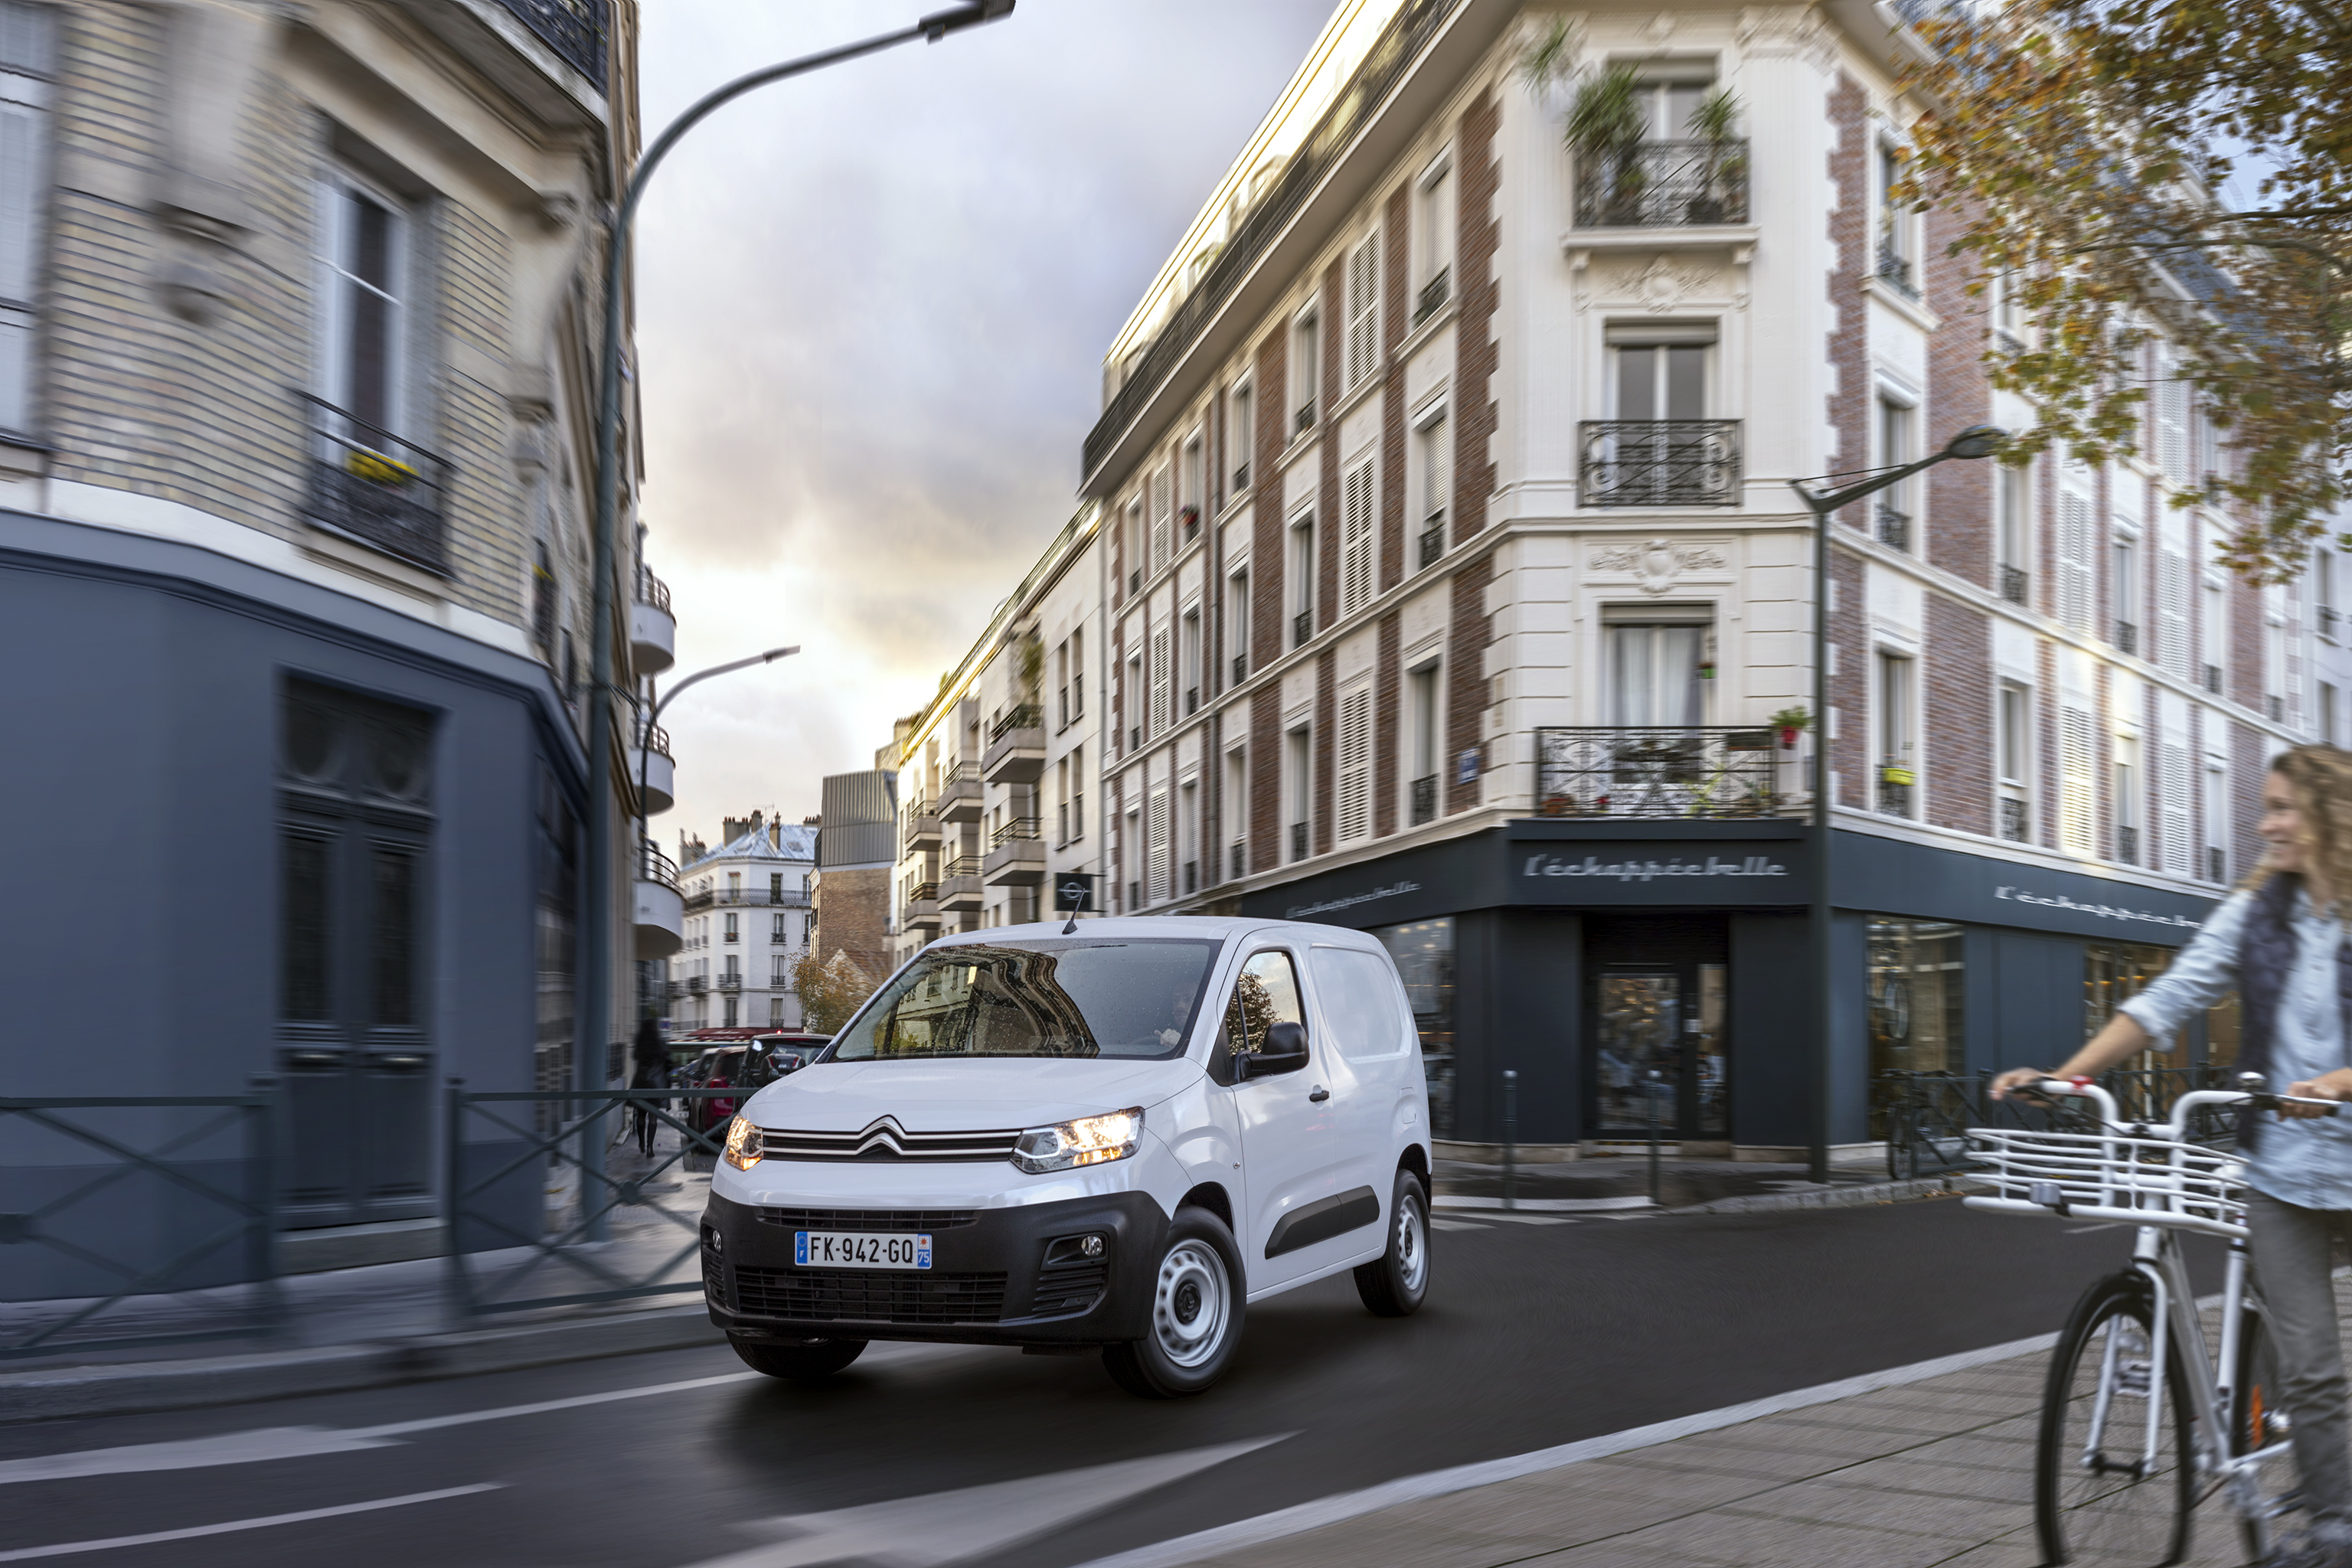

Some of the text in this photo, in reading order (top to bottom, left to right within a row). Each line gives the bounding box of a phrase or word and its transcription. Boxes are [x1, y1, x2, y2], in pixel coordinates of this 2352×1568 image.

[799, 1250, 805, 1258] F
[810, 1236, 913, 1263] FK-942-GQ
[918, 1251, 930, 1263] 75
